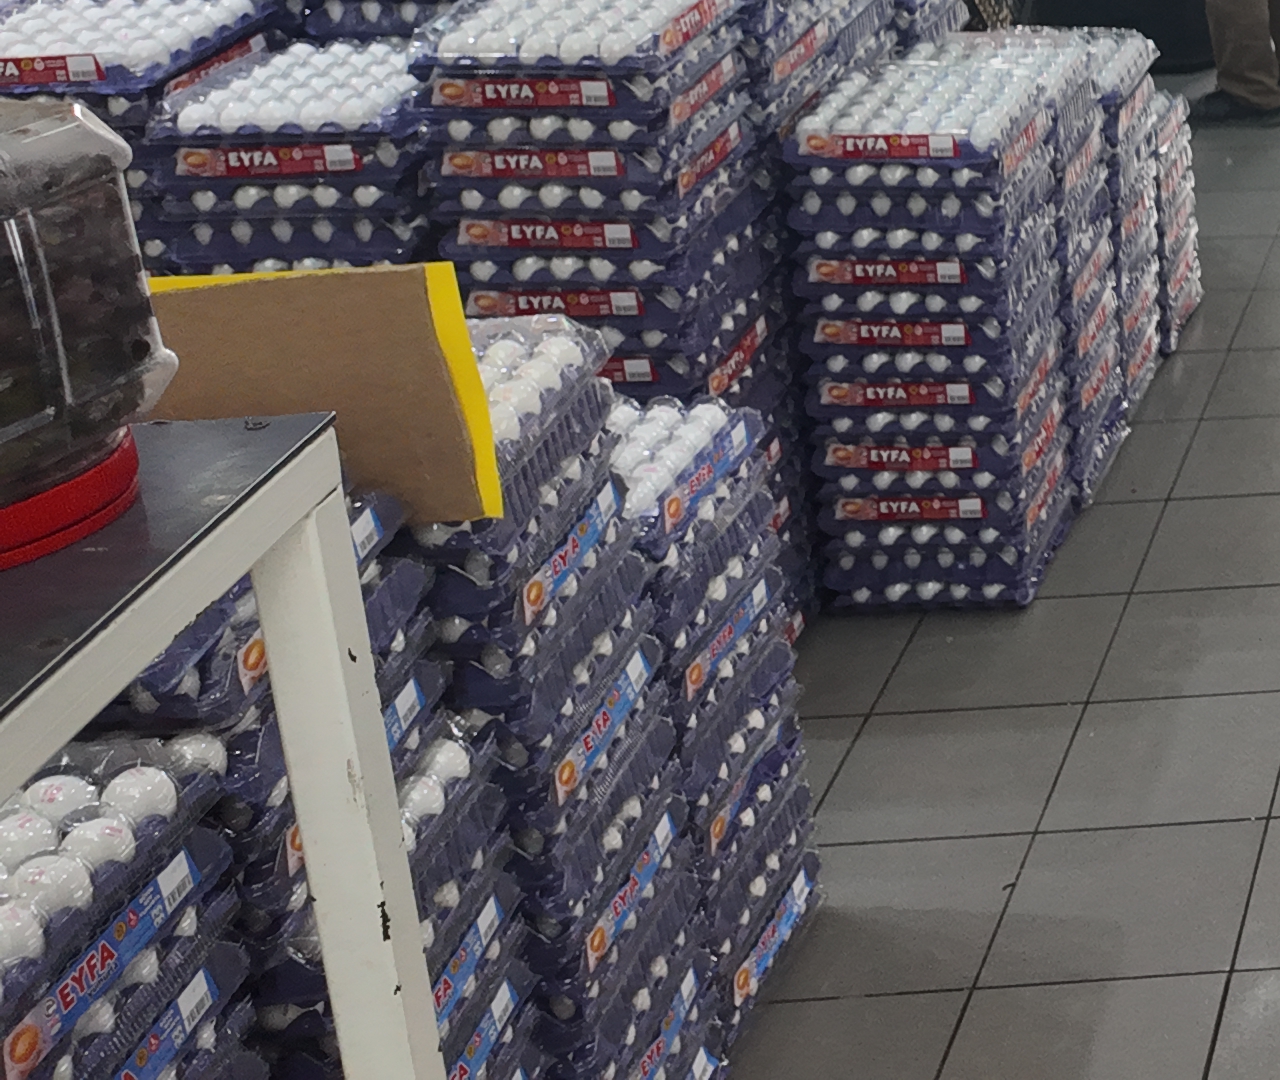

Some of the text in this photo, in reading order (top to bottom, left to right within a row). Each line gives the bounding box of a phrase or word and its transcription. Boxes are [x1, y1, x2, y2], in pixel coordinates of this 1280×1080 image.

[484, 83, 534, 99] EYFA
[845, 137, 888, 151] EYFA
[228, 151, 278, 167] EYFA
[494, 155, 544, 170] EYFA
[510, 224, 559, 240] EYFA
[855, 264, 897, 277] EYFA
[518, 295, 565, 310] EYFA
[860, 325, 902, 338] EYFA
[866, 387, 907, 399] EYFA
[870, 450, 910, 462] EYFA
[879, 501, 920, 513] EYFA
[56, 939, 118, 1014] EYFA
